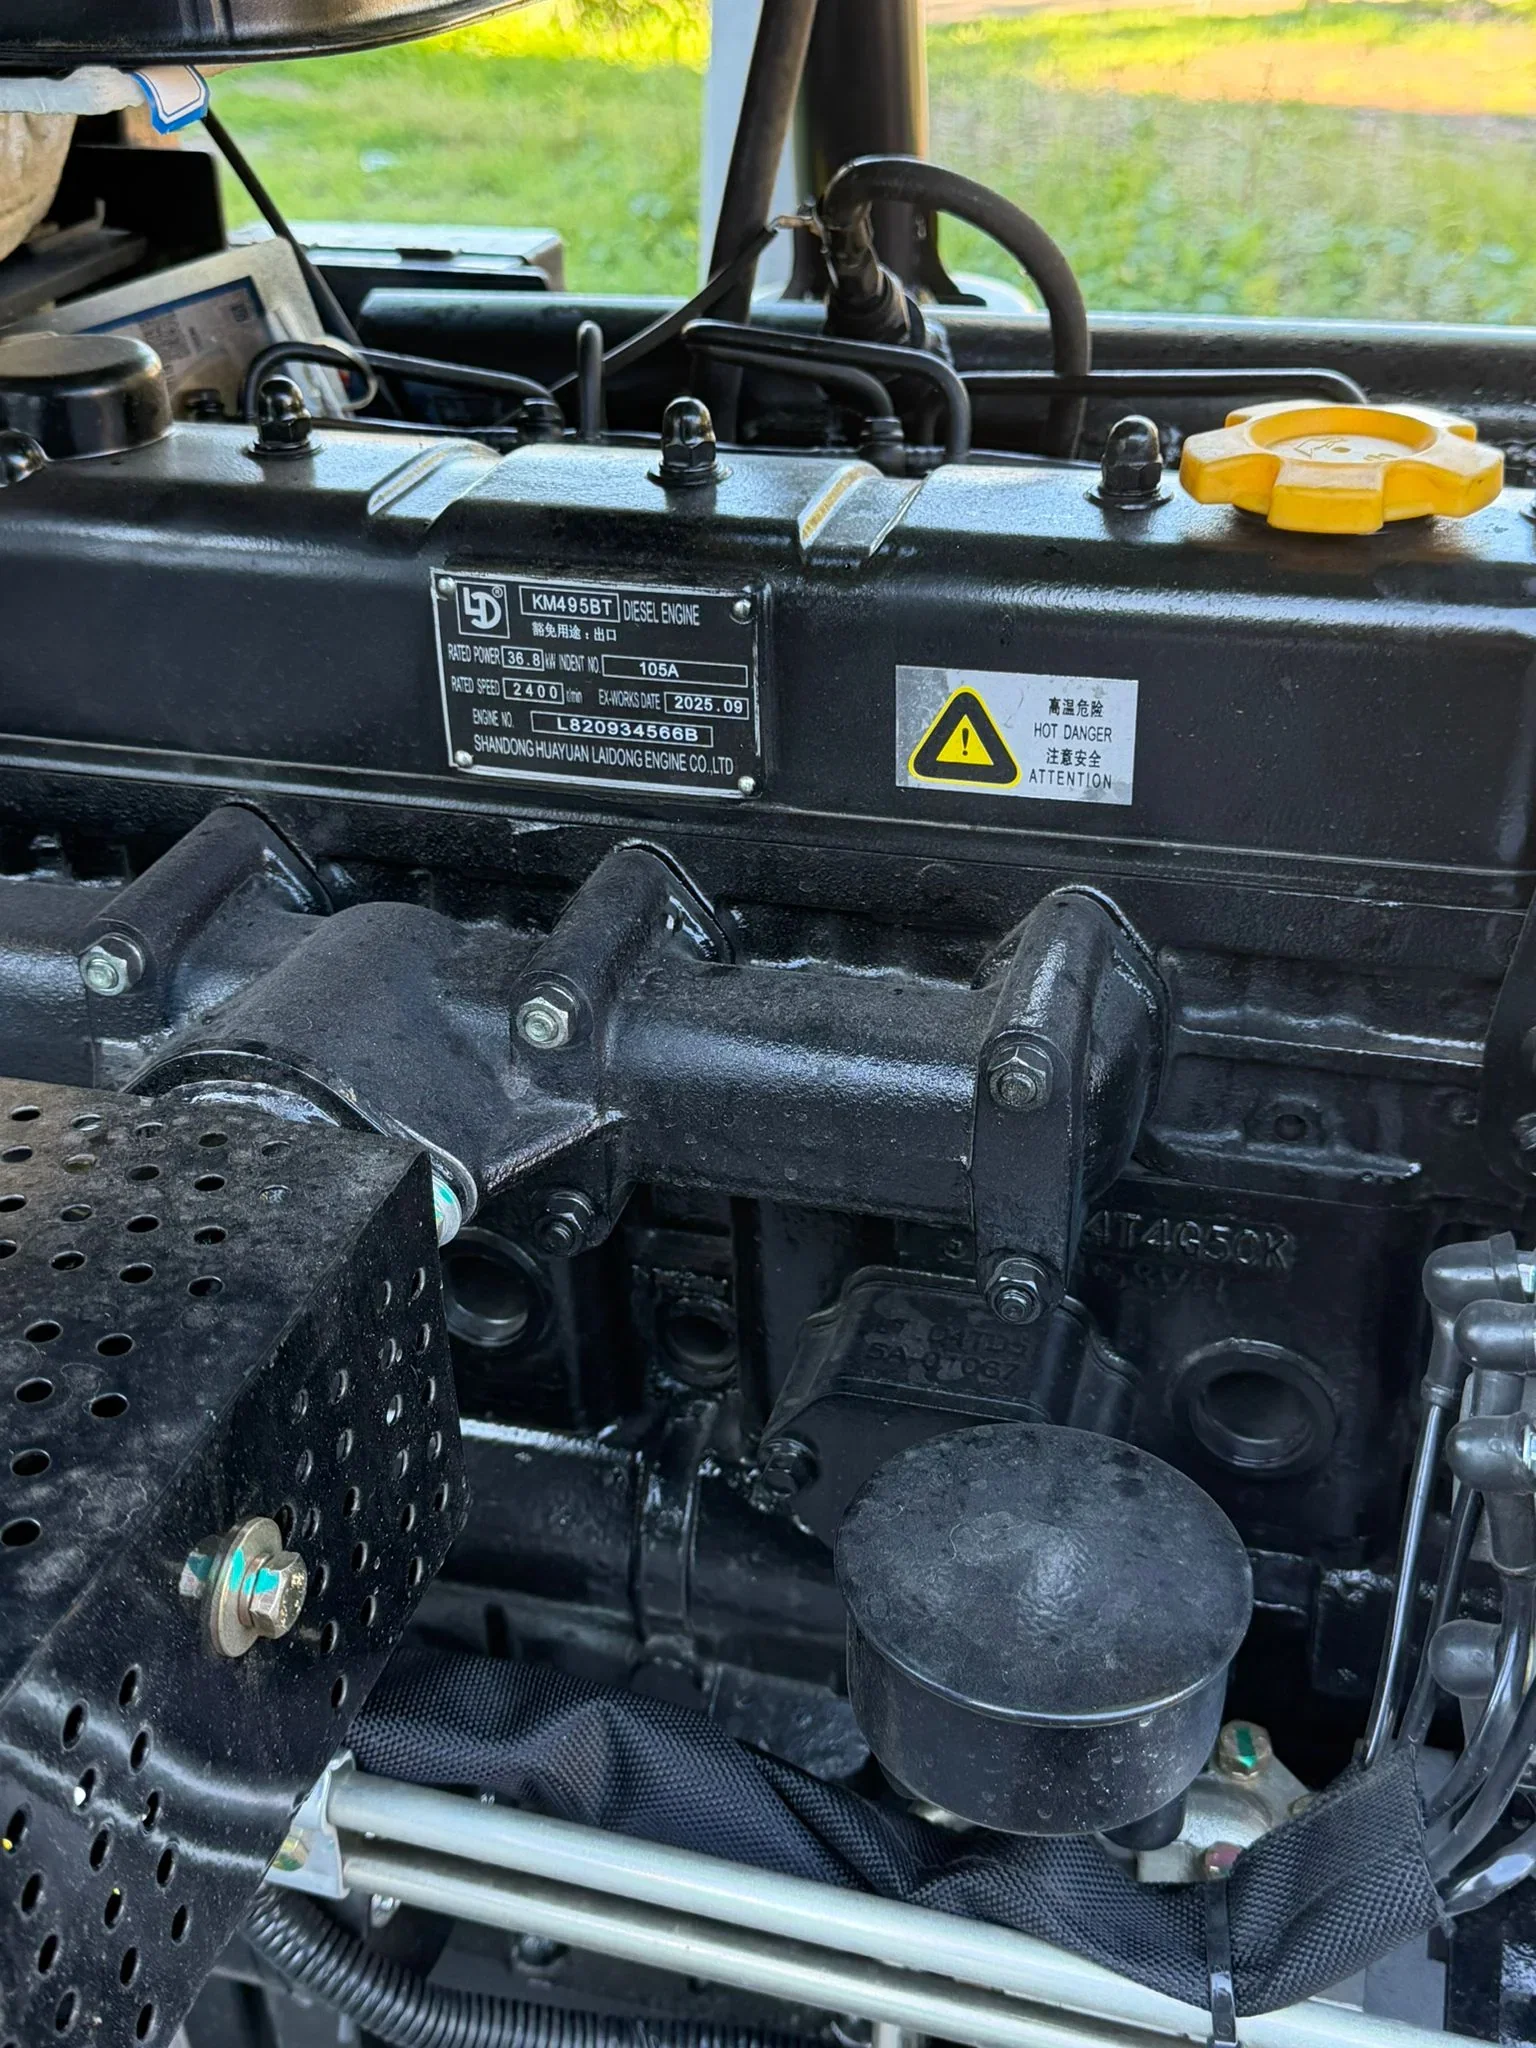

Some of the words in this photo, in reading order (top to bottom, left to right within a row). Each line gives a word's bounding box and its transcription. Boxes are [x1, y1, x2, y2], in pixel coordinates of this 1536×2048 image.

[532, 593, 612, 616] KM495BT
[623, 599, 660, 624] DIESEL
[661, 602, 700, 627] ENGINE
[447, 643, 472, 663] RATED
[473, 645, 501, 665] POWER
[507, 650, 541, 667] 36.8
[558, 653, 585, 672] INDENT
[639, 661, 680, 678] 105A
[451, 675, 474, 694] RATED
[476, 678, 501, 696] SPEED
[513, 682, 558, 699] 2400
[598, 688, 639, 709] EX-WORKS
[640, 692, 661, 711] DATE
[674, 695, 743, 714] 2025.09
[1048, 696, 1104, 719] 高温危险
[472, 708, 500, 727] ENGINE
[556, 716, 699, 742] L820934566B
[1034, 722, 1059, 740] HOT
[1063, 724, 1113, 743] DANGER
[473, 733, 534, 758] SHANDONG
[535, 739, 590, 763] HUAYUAN
[591, 745, 643, 768] LAIDONG
[644, 750, 687, 772] ENGINE
[1046, 747, 1102, 769] 注意安全
[1029, 768, 1113, 790] ATTENTION
